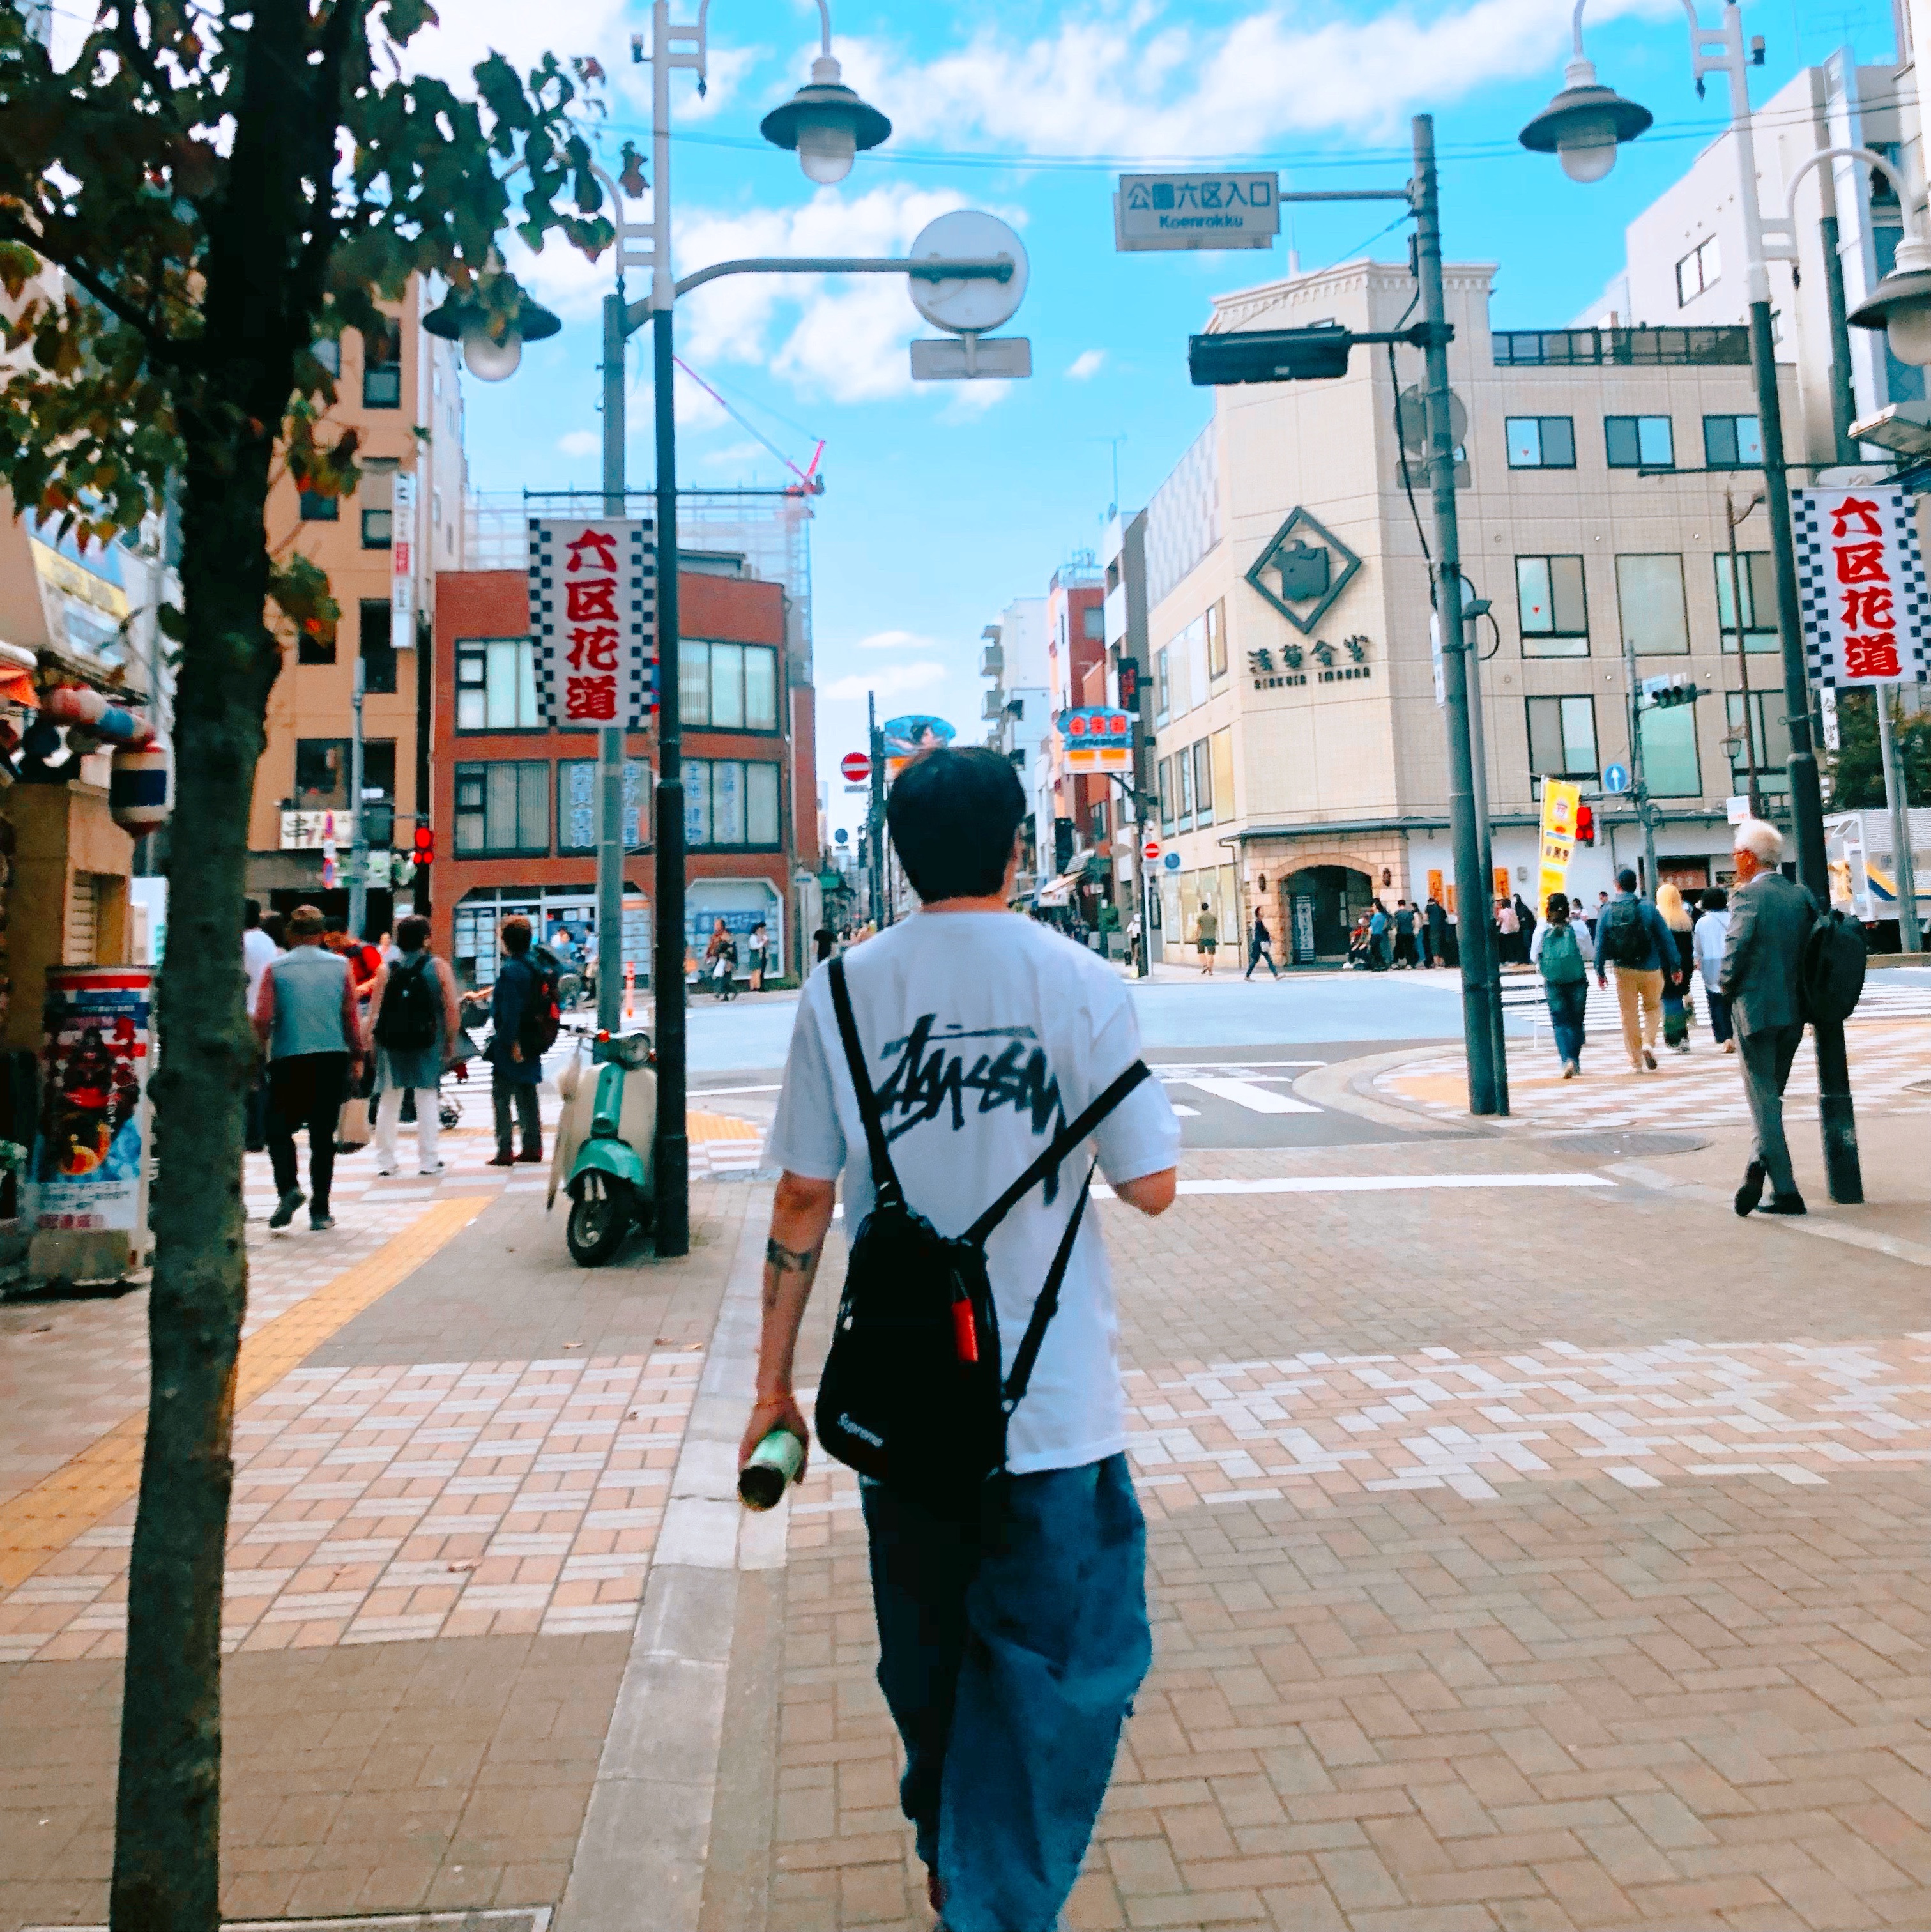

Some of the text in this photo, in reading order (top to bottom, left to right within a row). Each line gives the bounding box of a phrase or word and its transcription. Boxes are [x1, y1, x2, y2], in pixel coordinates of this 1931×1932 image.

[1127, 181, 1271, 211] 公園六区入口
[565, 529, 620, 719] 六区花道
[1829, 496, 1903, 678] 六区花道
